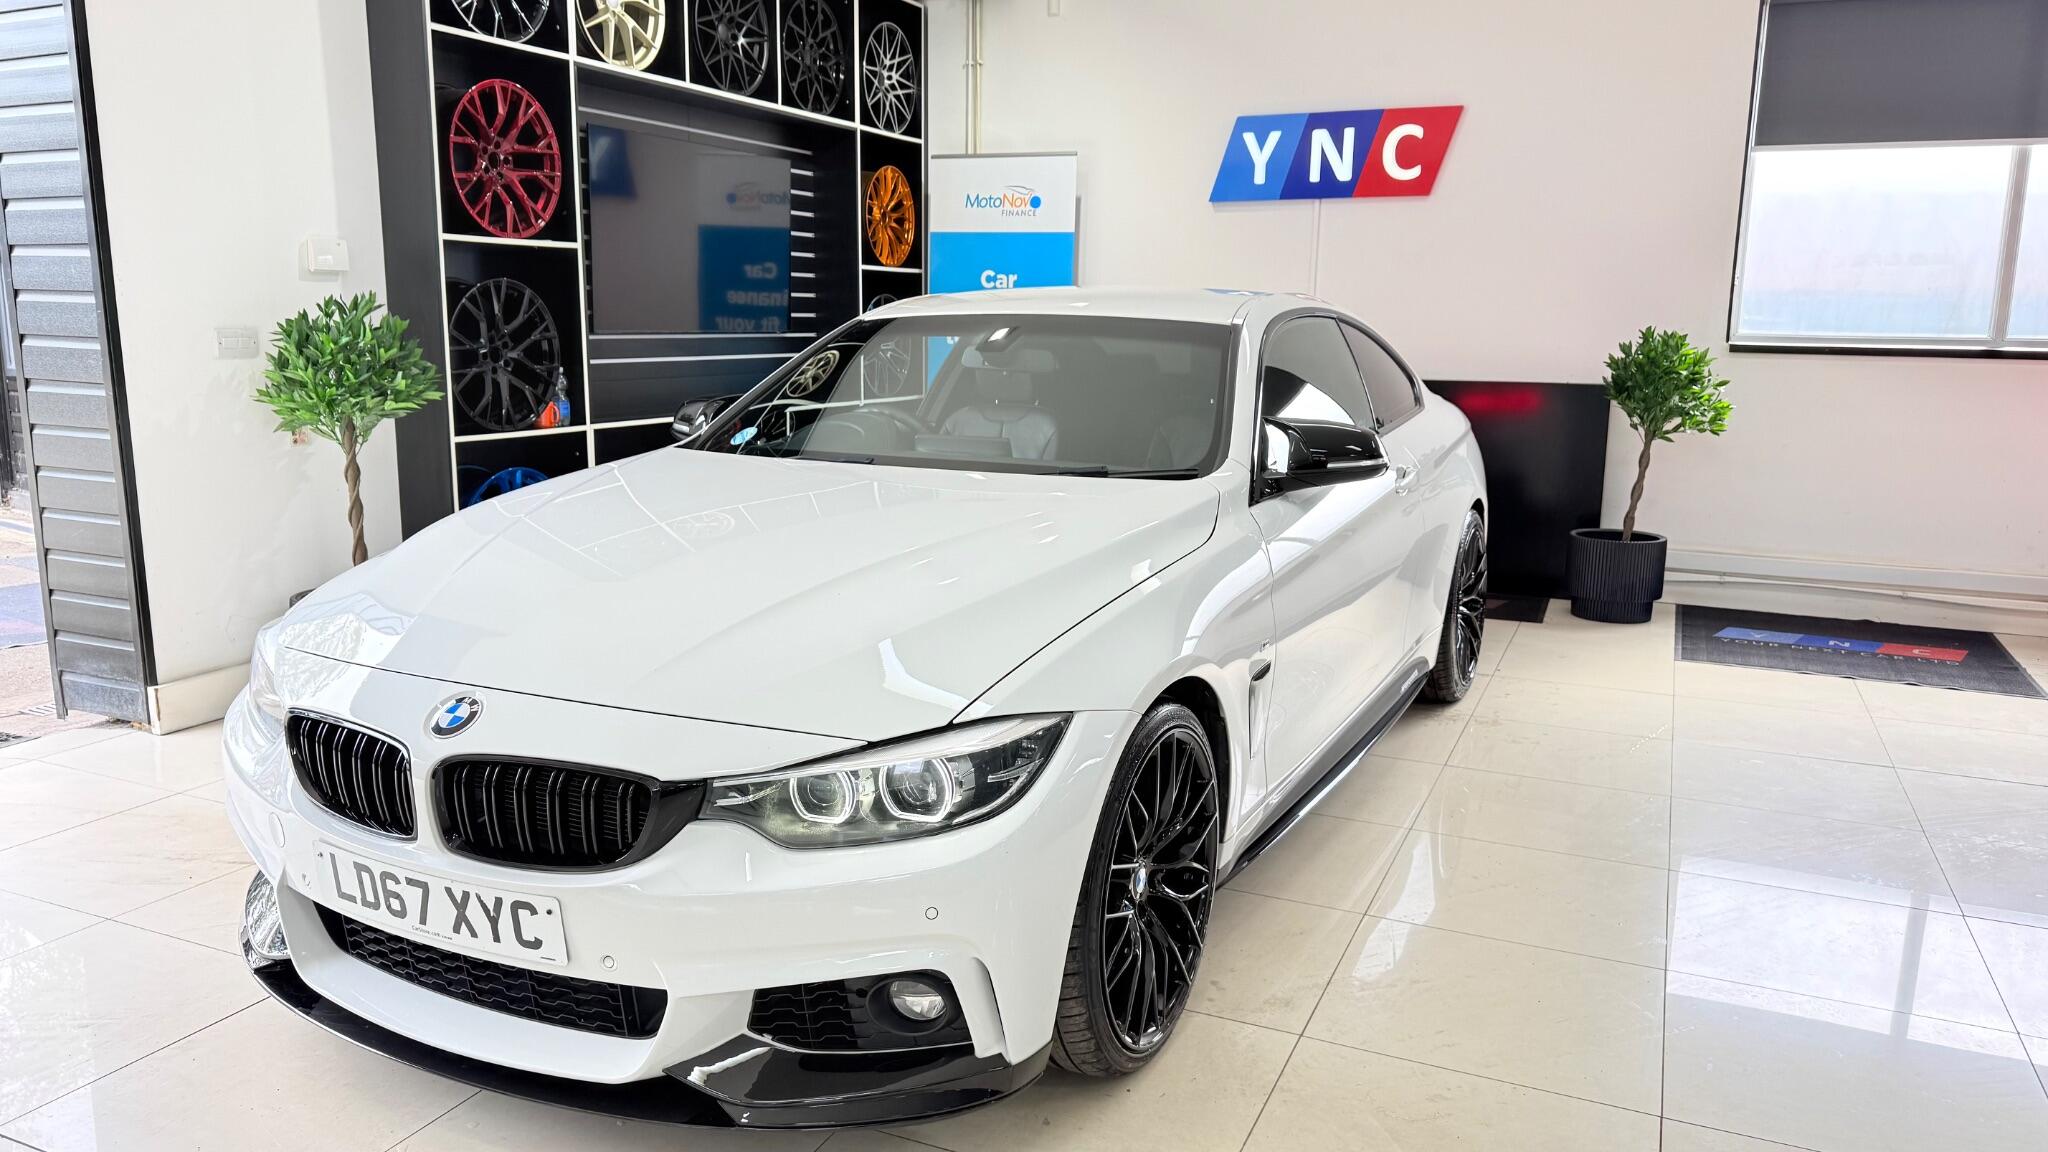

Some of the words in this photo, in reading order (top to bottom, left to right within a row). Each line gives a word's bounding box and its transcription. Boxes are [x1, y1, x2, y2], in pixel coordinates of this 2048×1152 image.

[1242, 123, 1424, 185] YNC
[965, 192, 1041, 209] MotoNovo
[1001, 209, 1038, 217] FINANCE
[980, 269, 1018, 289] Car
[1721, 638, 1779, 647] YOUR
[1791, 644, 1849, 655] NEXT
[1860, 652, 1904, 660] CAR
[329, 852, 430, 926] LD67
[444, 886, 544, 951] XYC
